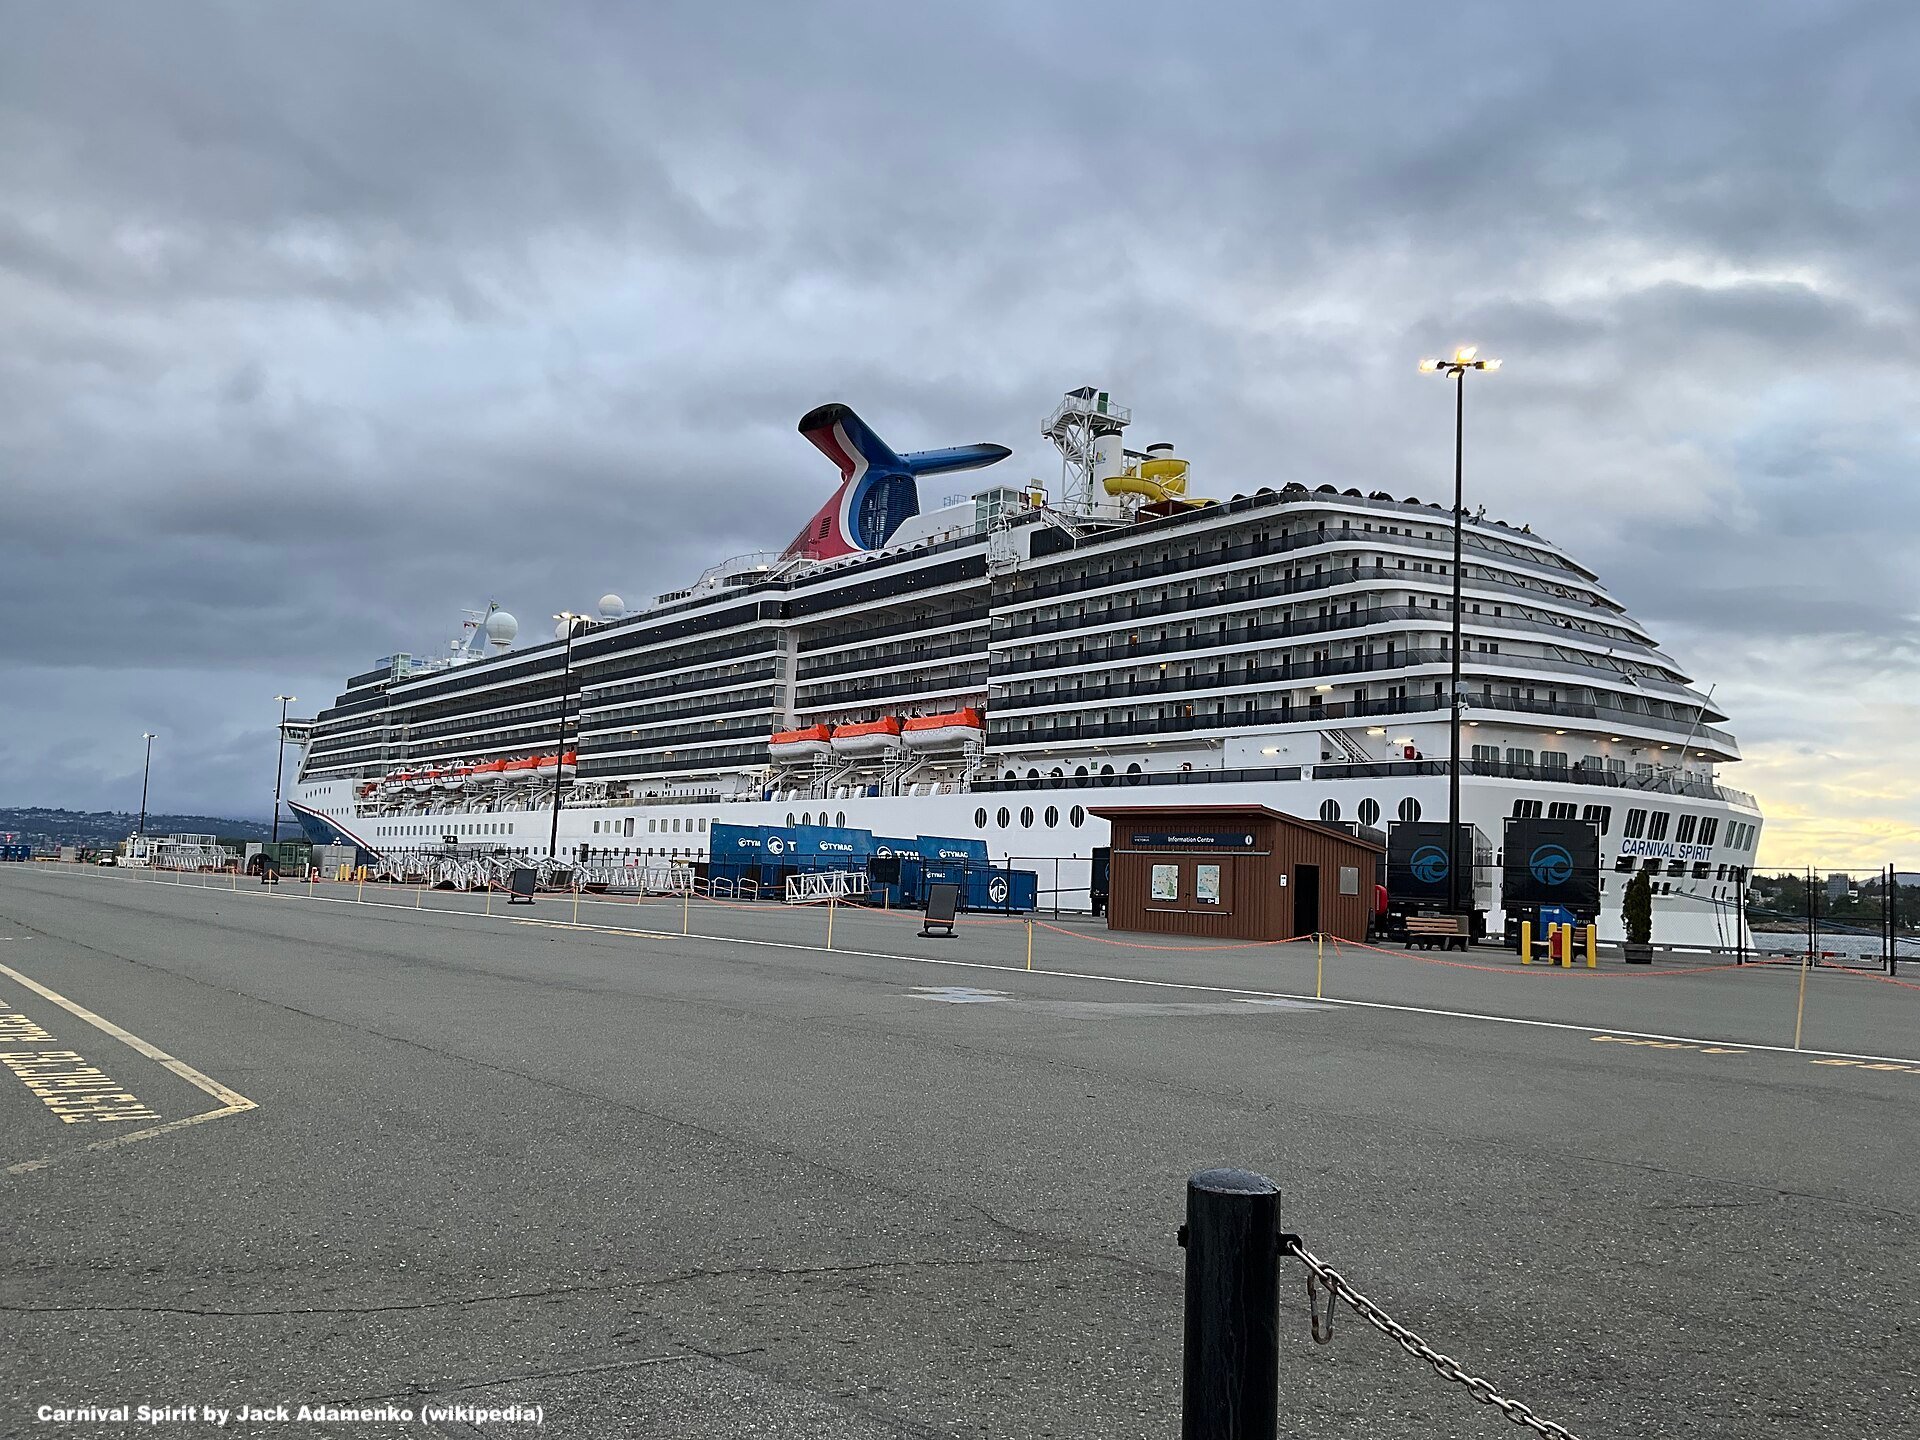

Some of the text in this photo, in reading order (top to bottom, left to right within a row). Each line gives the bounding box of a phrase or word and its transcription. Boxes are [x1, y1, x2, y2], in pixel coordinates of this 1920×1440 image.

[828, 842, 853, 852] TYMAC
[1622, 839, 1713, 860] CARNIVAL SPIRIT
[946, 850, 969, 859] TYMAC
